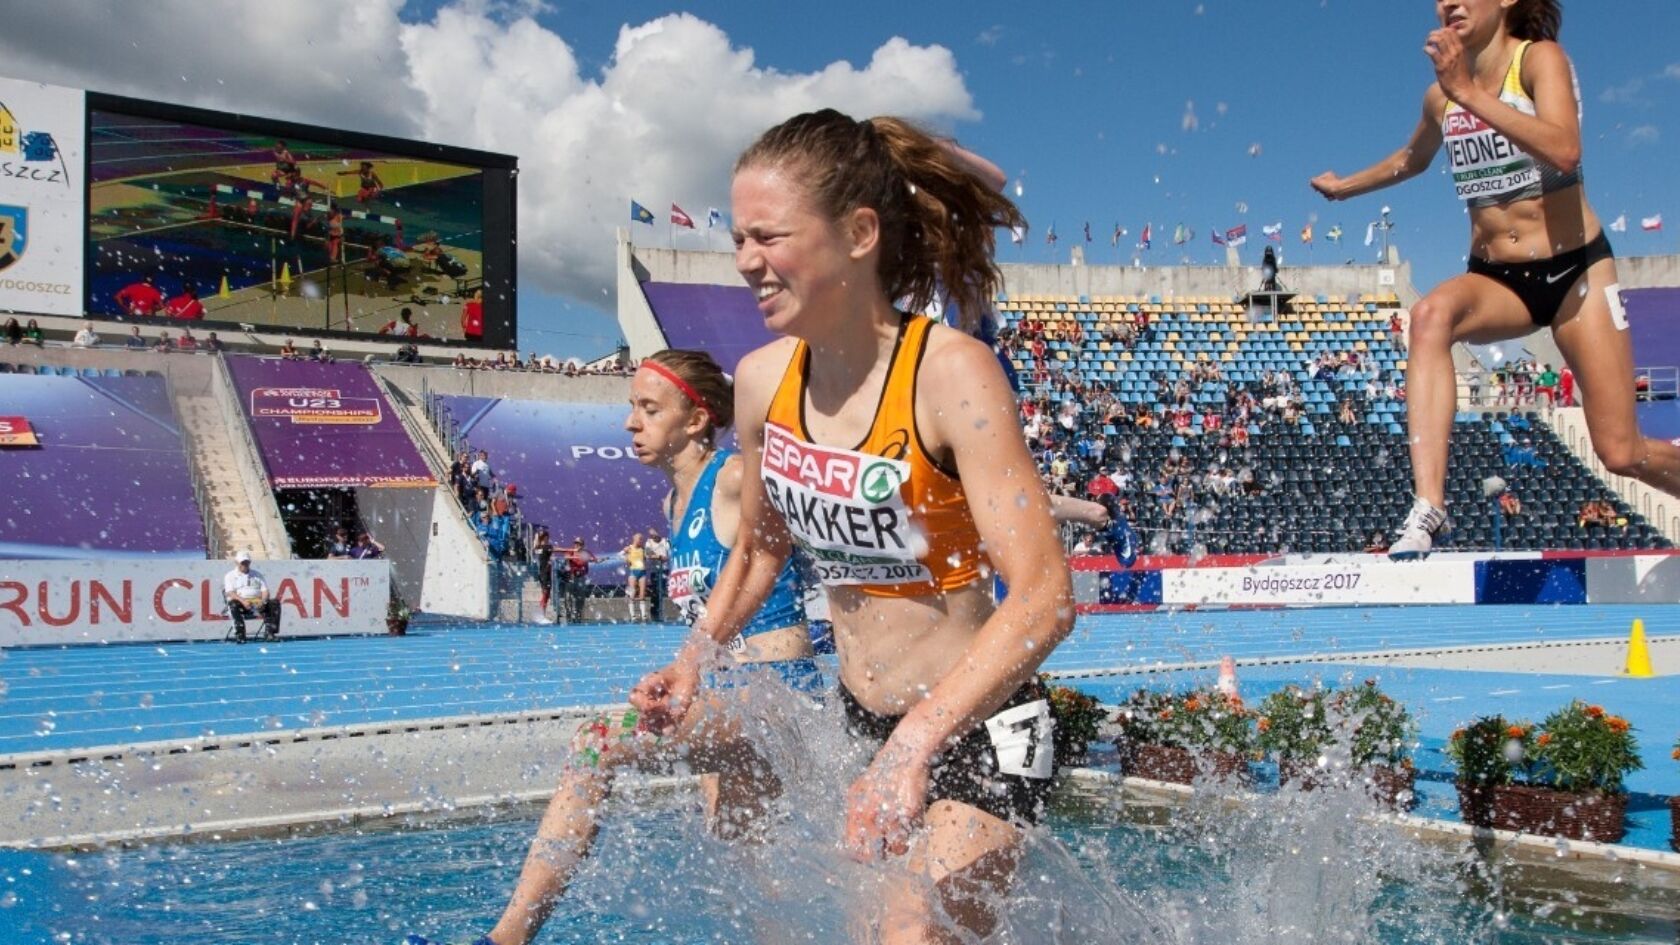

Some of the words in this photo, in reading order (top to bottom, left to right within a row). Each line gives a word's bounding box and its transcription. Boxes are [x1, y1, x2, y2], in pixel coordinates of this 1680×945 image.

[1446, 114, 1482, 133] PA
[1, 161, 62, 183] SZCZ
[1507, 170, 1533, 187] 2017
[259, 408, 375, 416] CHAMPIONSHIPS
[288, 398, 342, 409] U23
[766, 436, 855, 492] SPAR
[765, 475, 906, 550] BAKKER
[881, 564, 923, 580] 2017
[667, 573, 690, 595] PAR
[1243, 575, 1321, 596] Bydgoszcz
[1323, 573, 1361, 590] 2017
[0, 580, 133, 627] RUN
[153, 577, 350, 623] CLAN
[1010, 715, 1040, 769] 7
